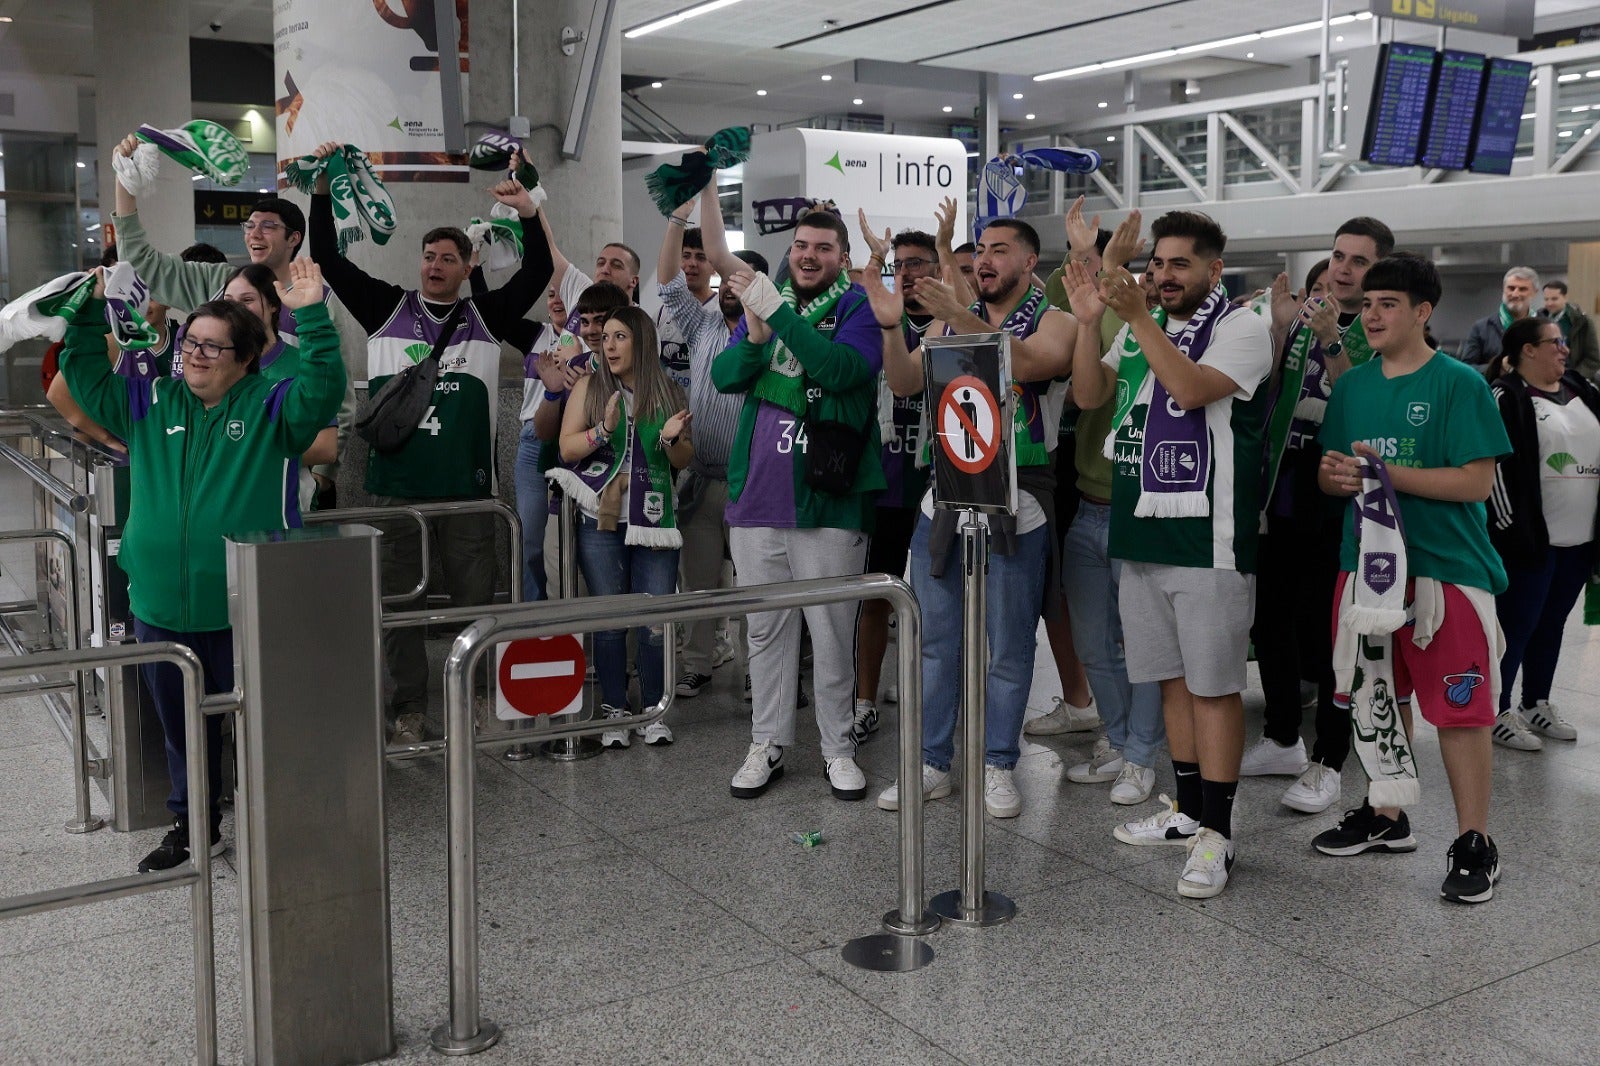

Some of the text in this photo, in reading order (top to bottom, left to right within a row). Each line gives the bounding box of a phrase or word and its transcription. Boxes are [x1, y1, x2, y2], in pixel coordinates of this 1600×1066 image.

[845, 159, 867, 168] aena
[896, 153, 952, 188] info
[776, 420, 809, 454] 34
[1400, 438, 1416, 447] 22
[1400, 447, 1415, 456] 23
